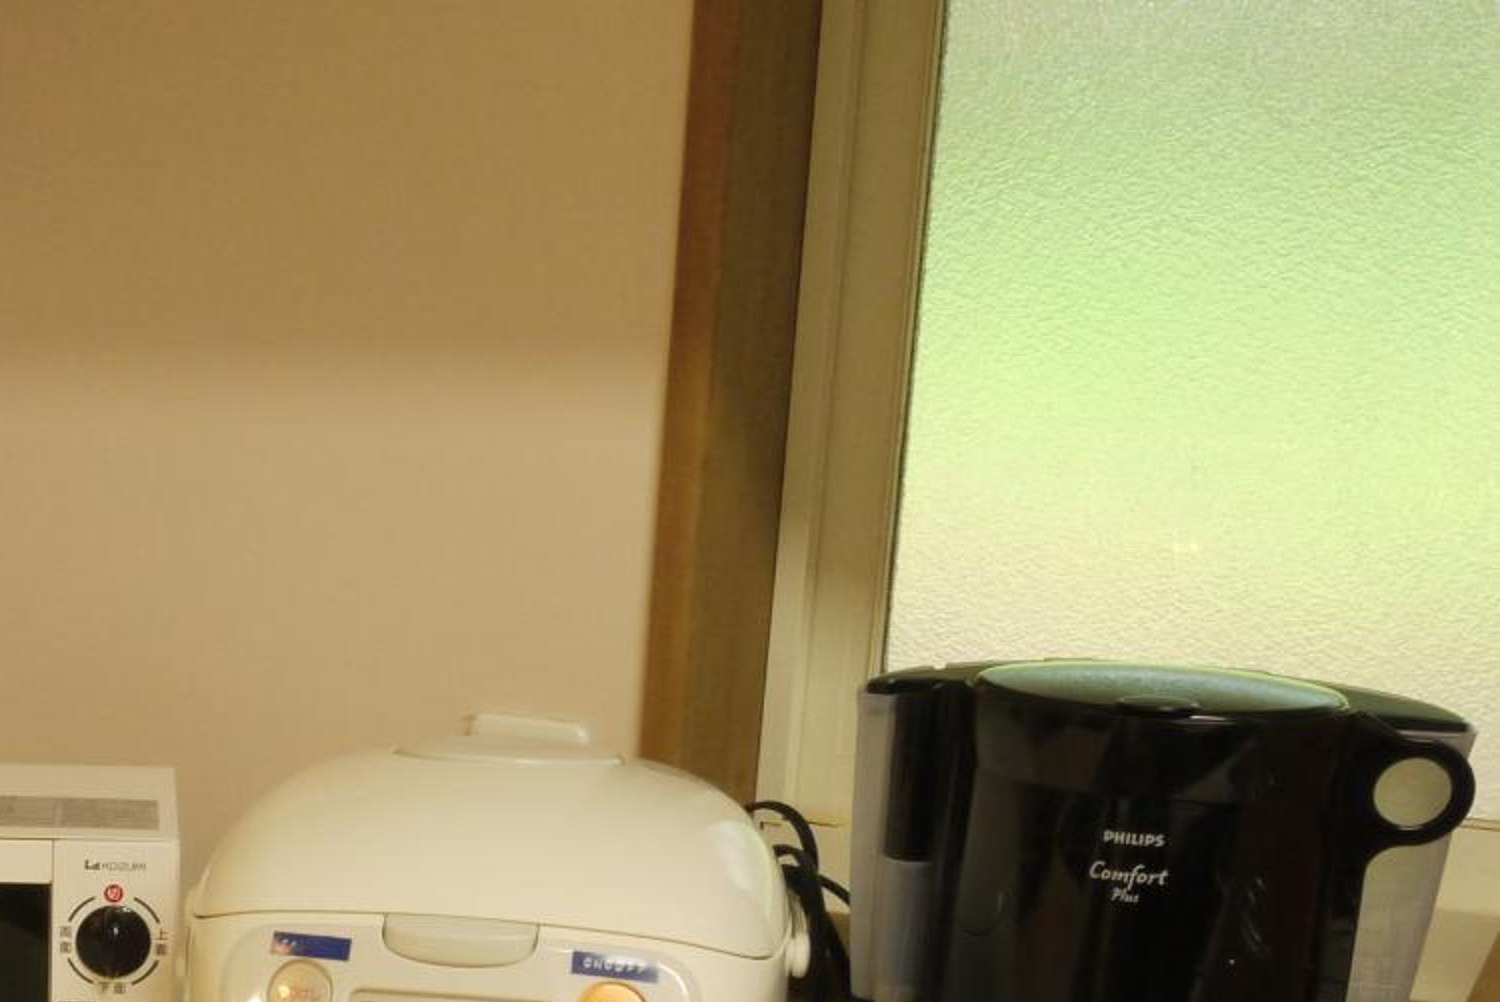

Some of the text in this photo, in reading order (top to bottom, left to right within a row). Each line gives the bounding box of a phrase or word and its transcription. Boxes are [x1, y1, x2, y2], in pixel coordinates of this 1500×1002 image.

[1103, 829, 1165, 847] PHILIPS
[1089, 860, 1169, 891] Comfort
[1111, 887, 1140, 903] Plus
